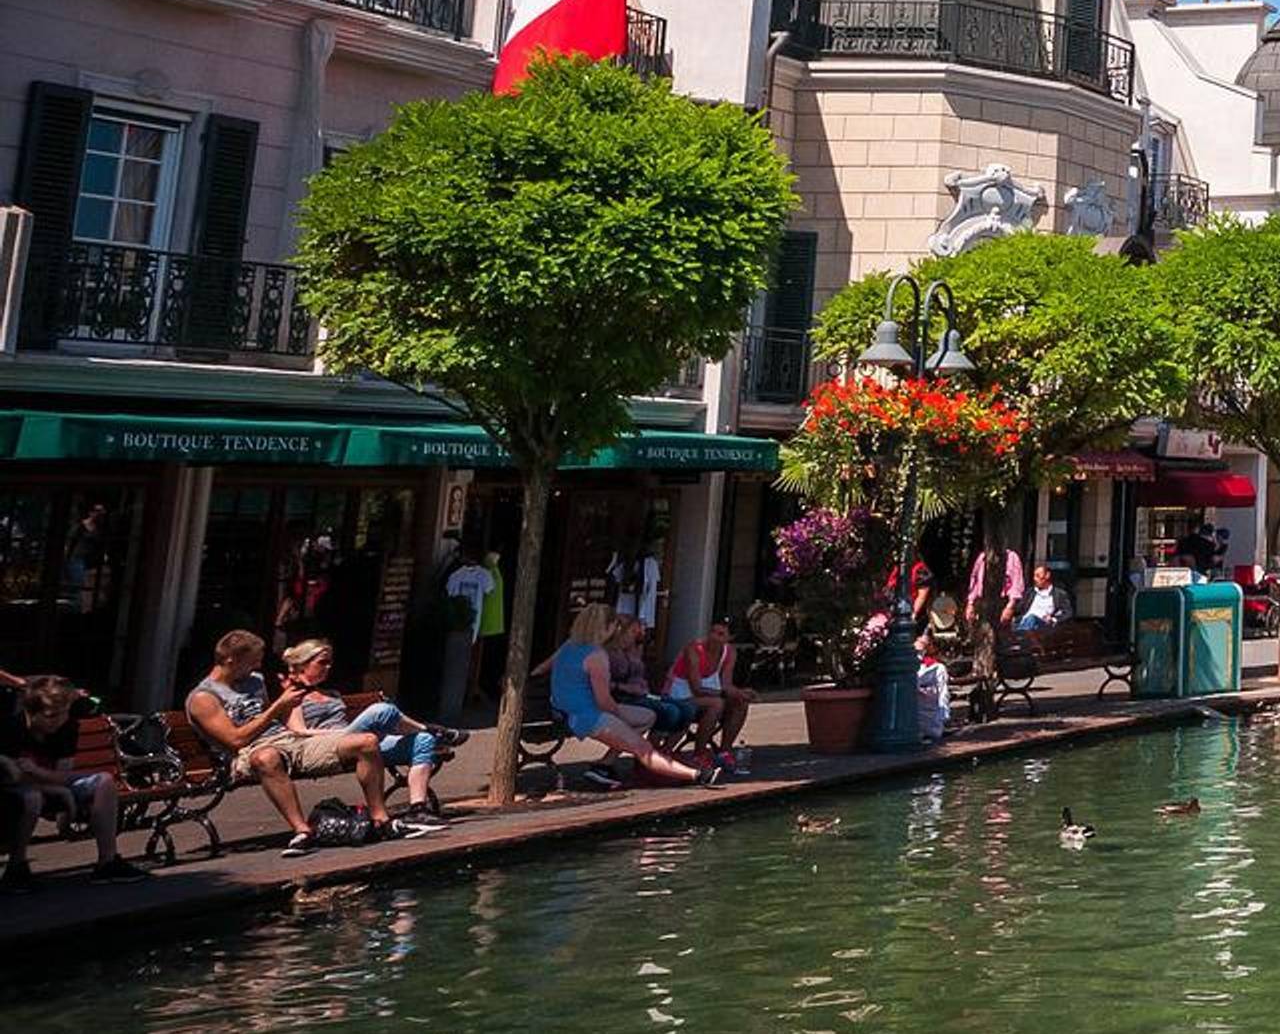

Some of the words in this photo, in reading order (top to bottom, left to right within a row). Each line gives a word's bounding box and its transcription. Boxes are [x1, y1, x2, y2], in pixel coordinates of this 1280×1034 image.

[123, 432, 214, 452] BOUTIQUE
[222, 435, 310, 452] TENDENCE
[423, 442, 491, 459] BOUTIQUE
[646, 448, 698, 462] BOUTIQUE
[704, 449, 754, 461] TENDENCE
